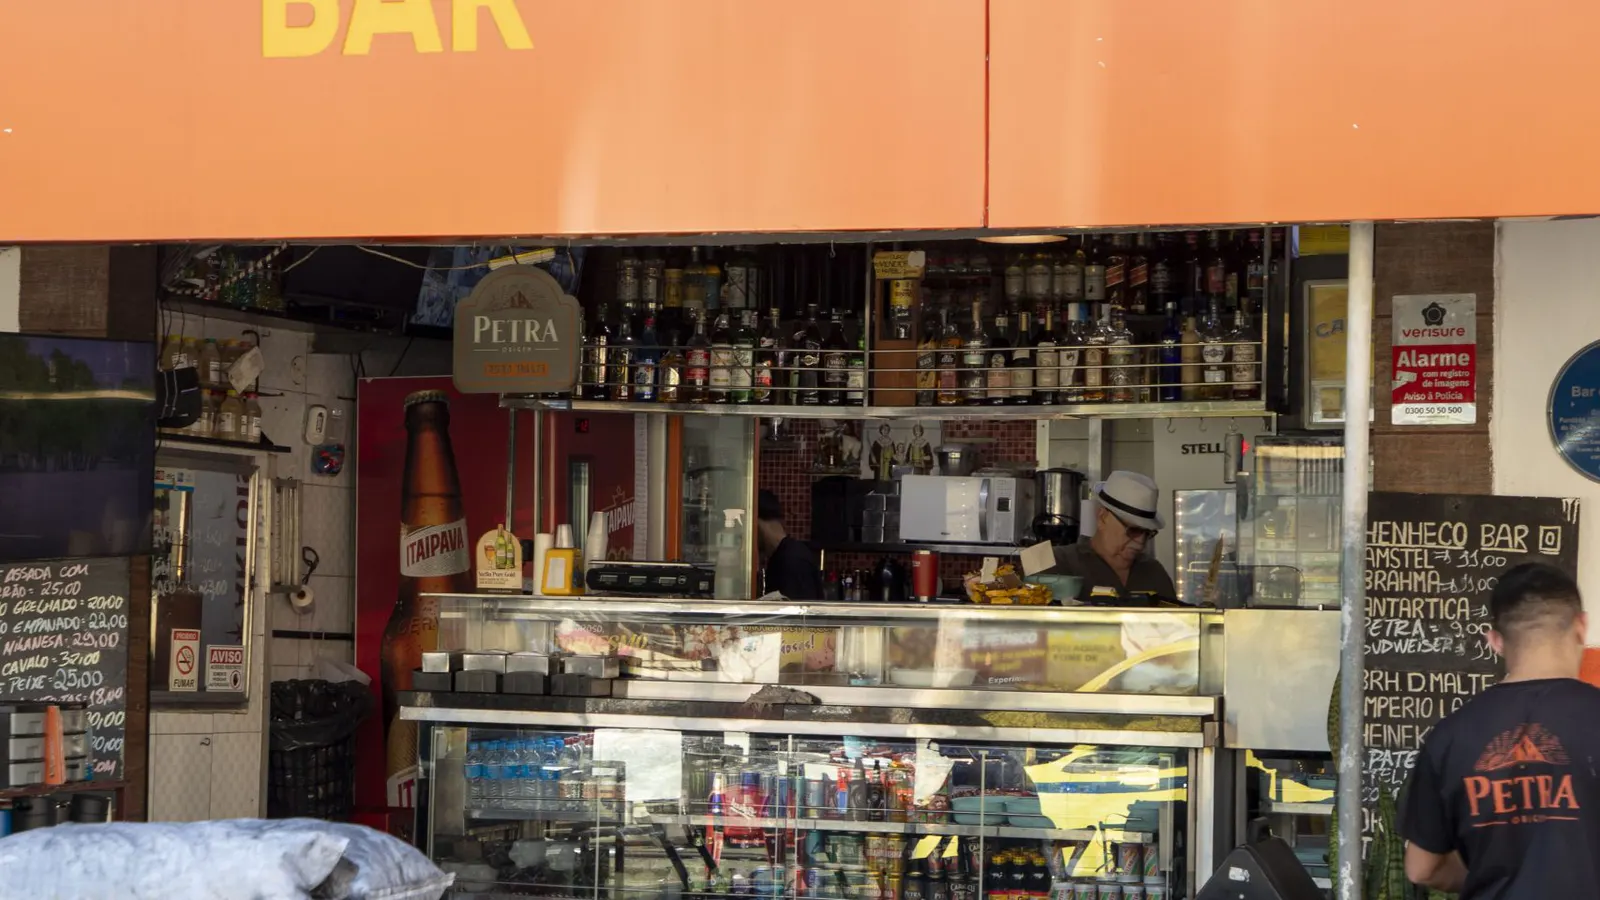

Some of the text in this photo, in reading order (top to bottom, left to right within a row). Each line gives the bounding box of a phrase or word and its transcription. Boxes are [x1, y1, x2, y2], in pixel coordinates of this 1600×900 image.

[473, 315, 559, 344] PETRA
[1402, 328, 1466, 338] verisure
[1397, 350, 1470, 368] Alarme
[1422, 378, 1470, 389] de imagens
[1440, 369, 1470, 380] registro
[1404, 392, 1426, 401] Aviso
[1571, 385, 1596, 397] Bar
[1405, 406, 1463, 415] 0300 50 50 500
[1181, 443, 1226, 455] STELL
[1365, 521, 1530, 550] HENHECO BAR
[406, 526, 465, 567] ITAIPAVA
[1365, 548, 1434, 569] AMSTEL
[4, 564, 89, 582] ASSADA COM
[1365, 570, 1440, 593] BRAHMA
[41, 581, 82, 596] 25,00
[88, 595, 124, 610] 20,00
[1364, 597, 1470, 620] ANTARTICA
[13, 616, 80, 635] EMPANADO
[88, 612, 128, 631] 22,00
[1364, 617, 1425, 638] PETRA
[72, 630, 120, 648] 29,00
[2, 654, 49, 676] CAVALO
[60, 651, 101, 667] 32,00
[211, 650, 242, 662] AVISO
[9, 675, 47, 694] PEIXE
[53, 668, 104, 691] 25,00
[173, 679, 194, 688] FUMAR
[1439, 698, 1471, 719] LA
[1363, 723, 1434, 750] HEINEK
[1463, 774, 1580, 816] PETRA
